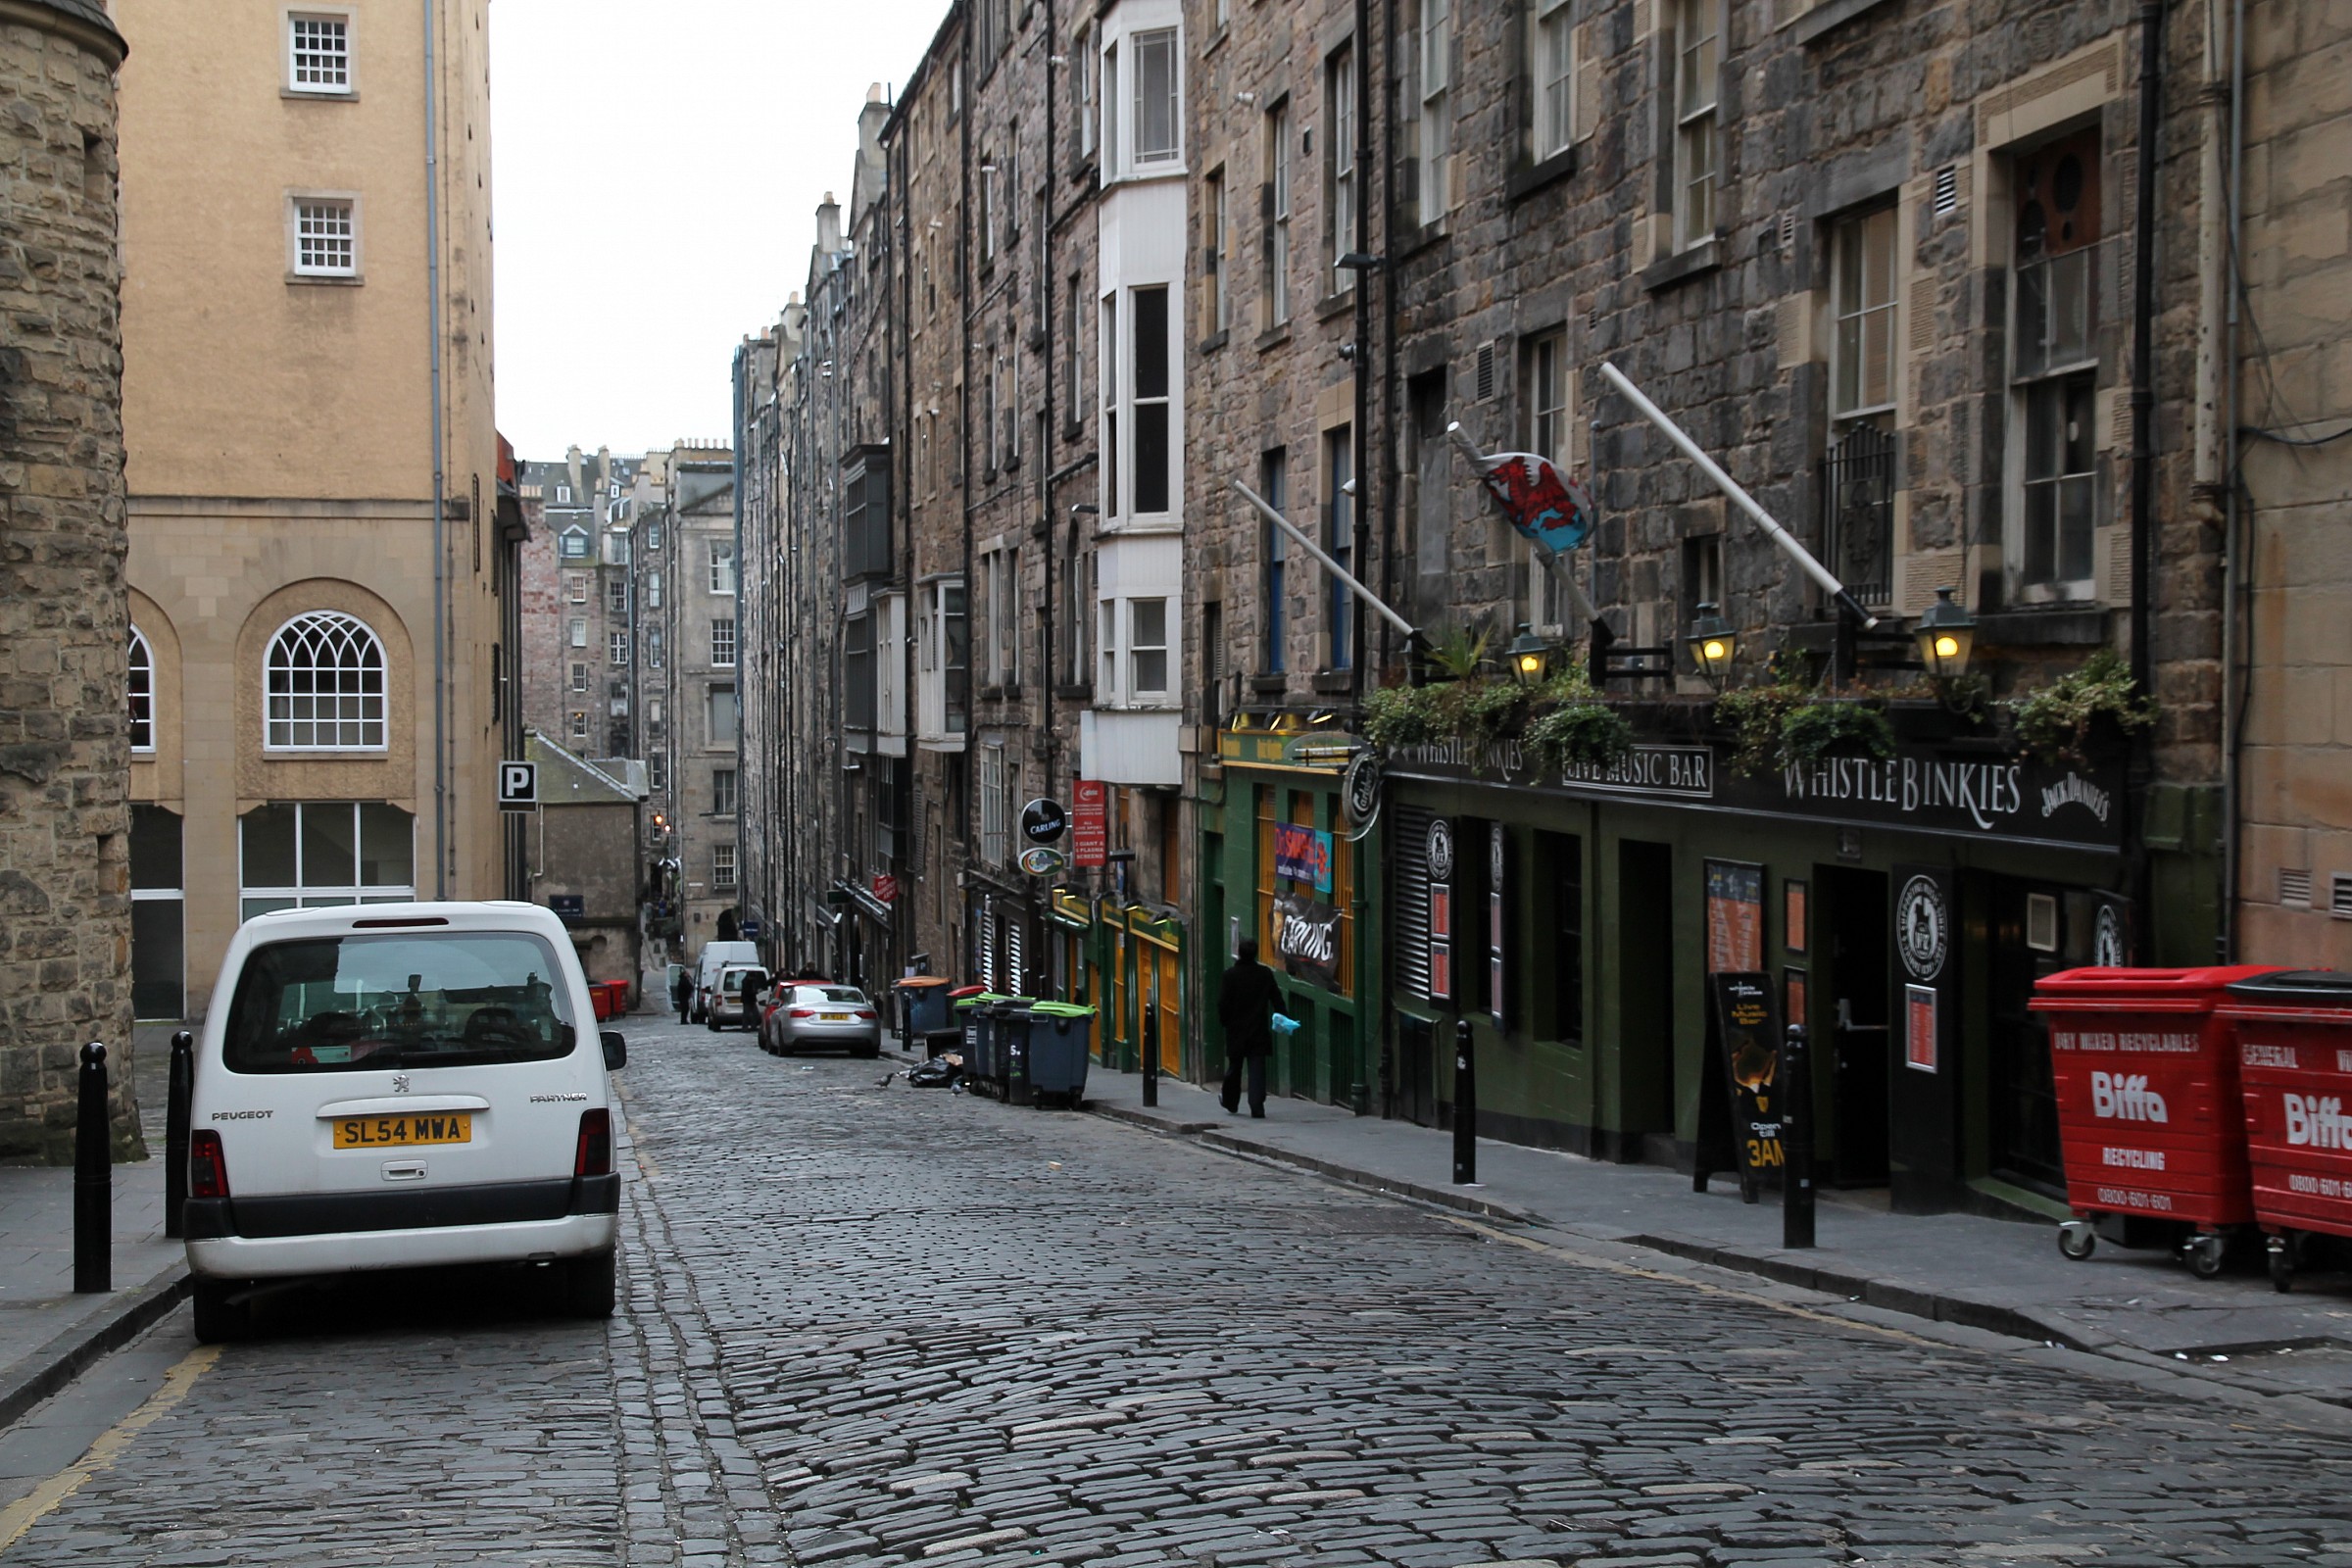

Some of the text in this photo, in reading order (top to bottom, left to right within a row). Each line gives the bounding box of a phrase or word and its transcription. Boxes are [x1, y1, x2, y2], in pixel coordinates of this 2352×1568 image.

[507, 767, 529, 797] P
[1669, 754, 1706, 788] BAR
[1030, 819, 1060, 834] CARLING
[530, 1093, 587, 1103] PARTNER
[2090, 1071, 2169, 1123] Biffa
[212, 1109, 273, 1121] PEUGEOT
[345, 1117, 461, 1144] SL54 MWA
[1750, 1122, 1782, 1132] Open
[2102, 1147, 2165, 1170] RECYCLING
